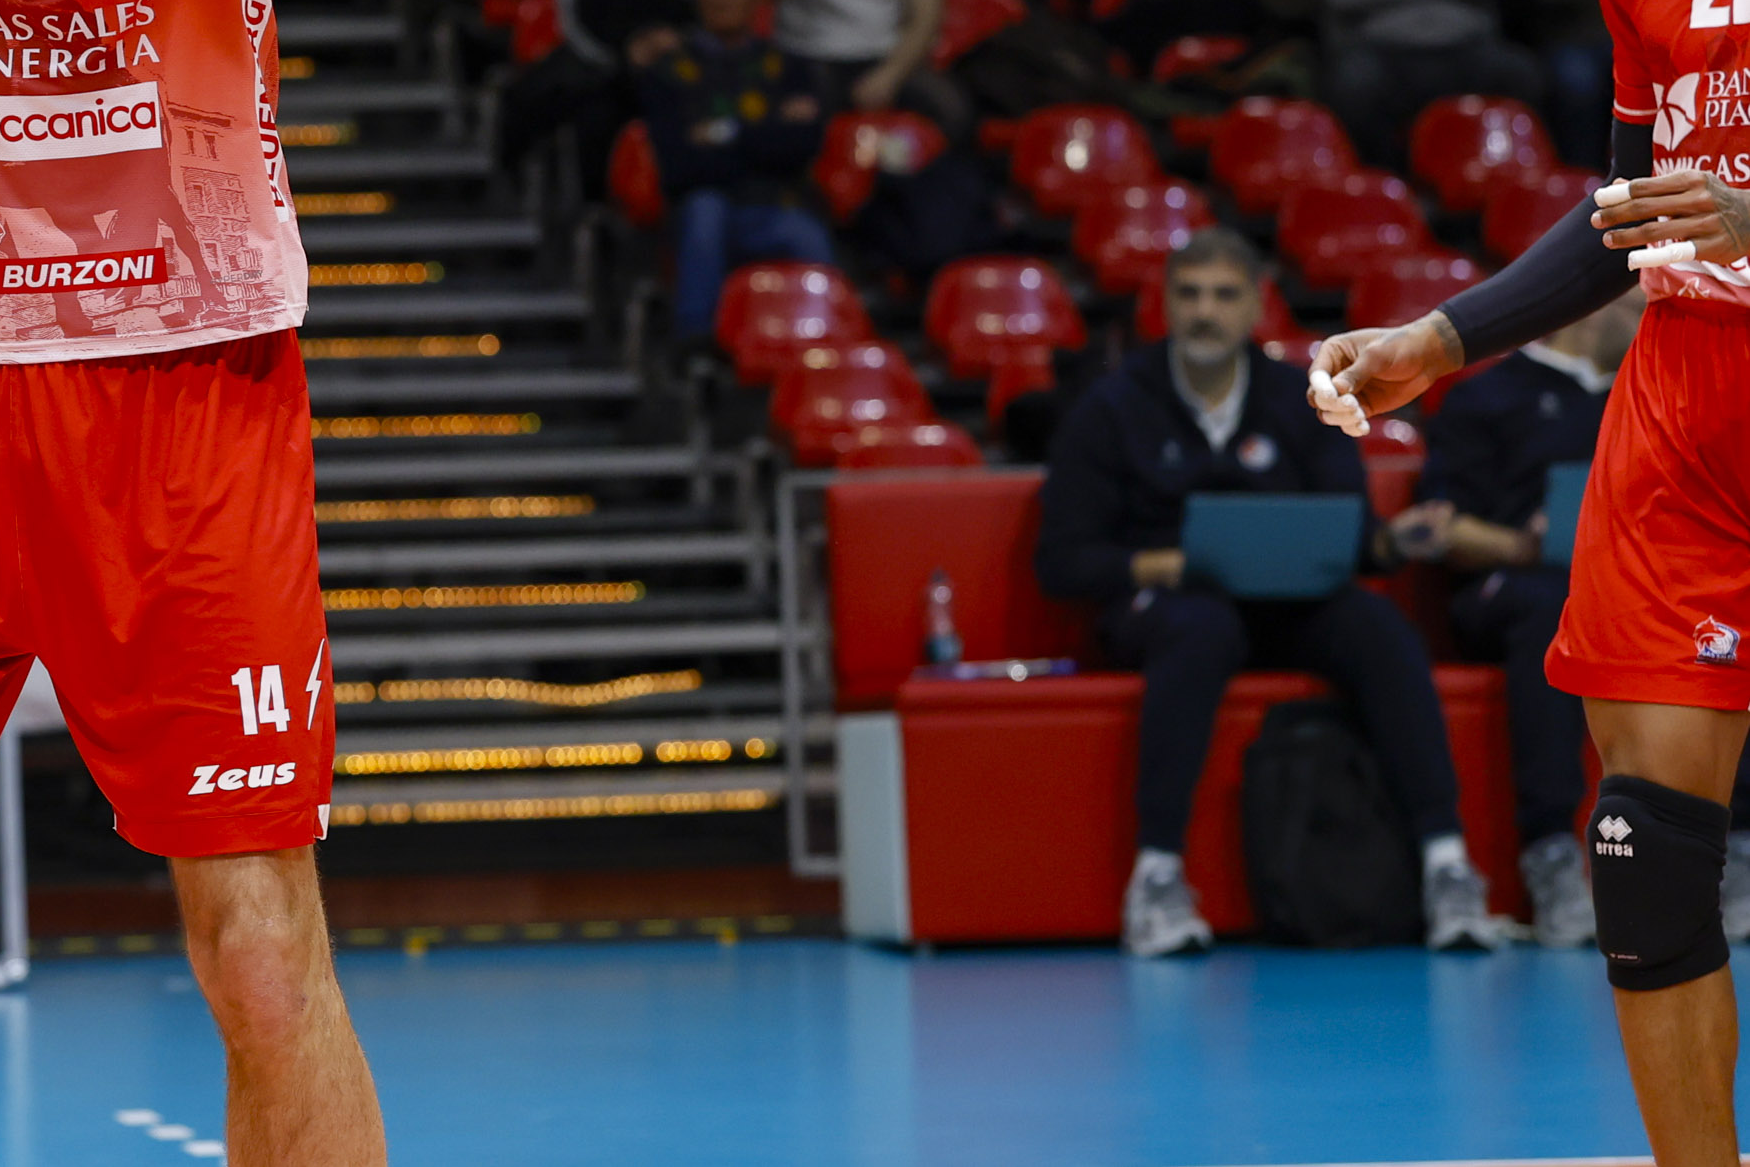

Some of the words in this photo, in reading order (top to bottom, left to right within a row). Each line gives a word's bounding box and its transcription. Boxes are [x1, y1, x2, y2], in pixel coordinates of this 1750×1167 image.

[1703, 98, 1750, 128] PIA
[2, 255, 155, 289] BURZONI
[231, 664, 291, 736] 14
[187, 761, 296, 796] Zeus
